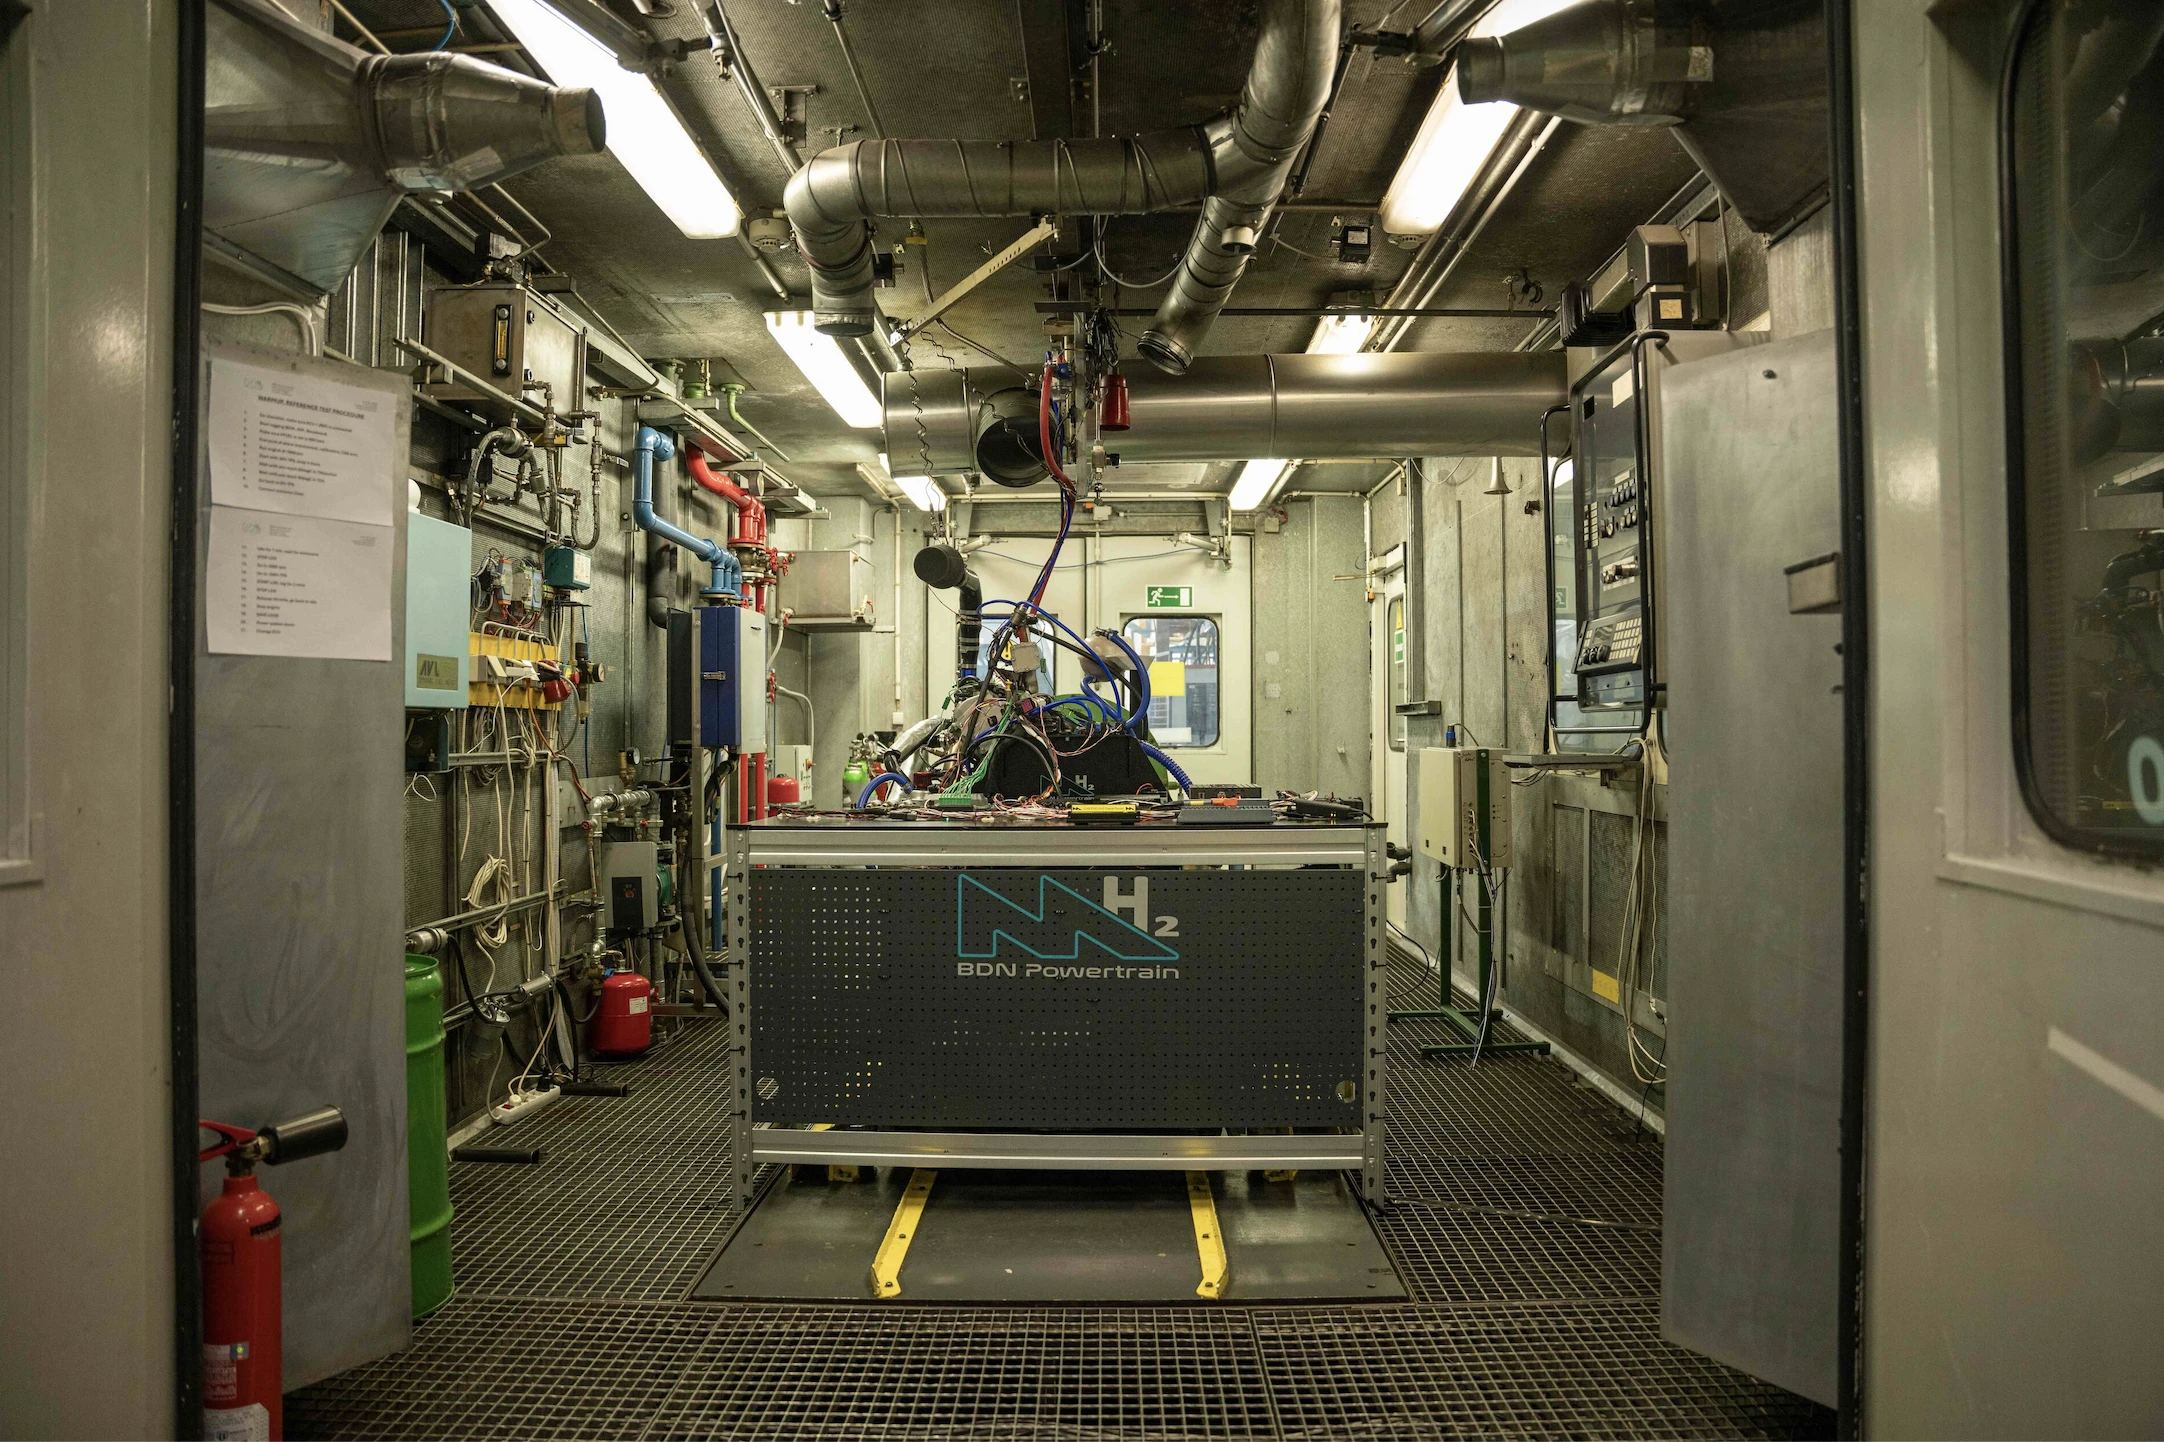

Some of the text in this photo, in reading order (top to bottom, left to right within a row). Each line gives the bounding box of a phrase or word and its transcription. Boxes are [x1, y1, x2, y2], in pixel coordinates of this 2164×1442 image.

[285, 399, 317, 412] REFERENCE
[319, 405, 330, 414] TEST
[332, 408, 364, 420] PROCEDURE
[420, 660, 440, 677] AVL
[1103, 876, 1180, 937] H2
[958, 962, 1180, 980] BDN Powertrain
